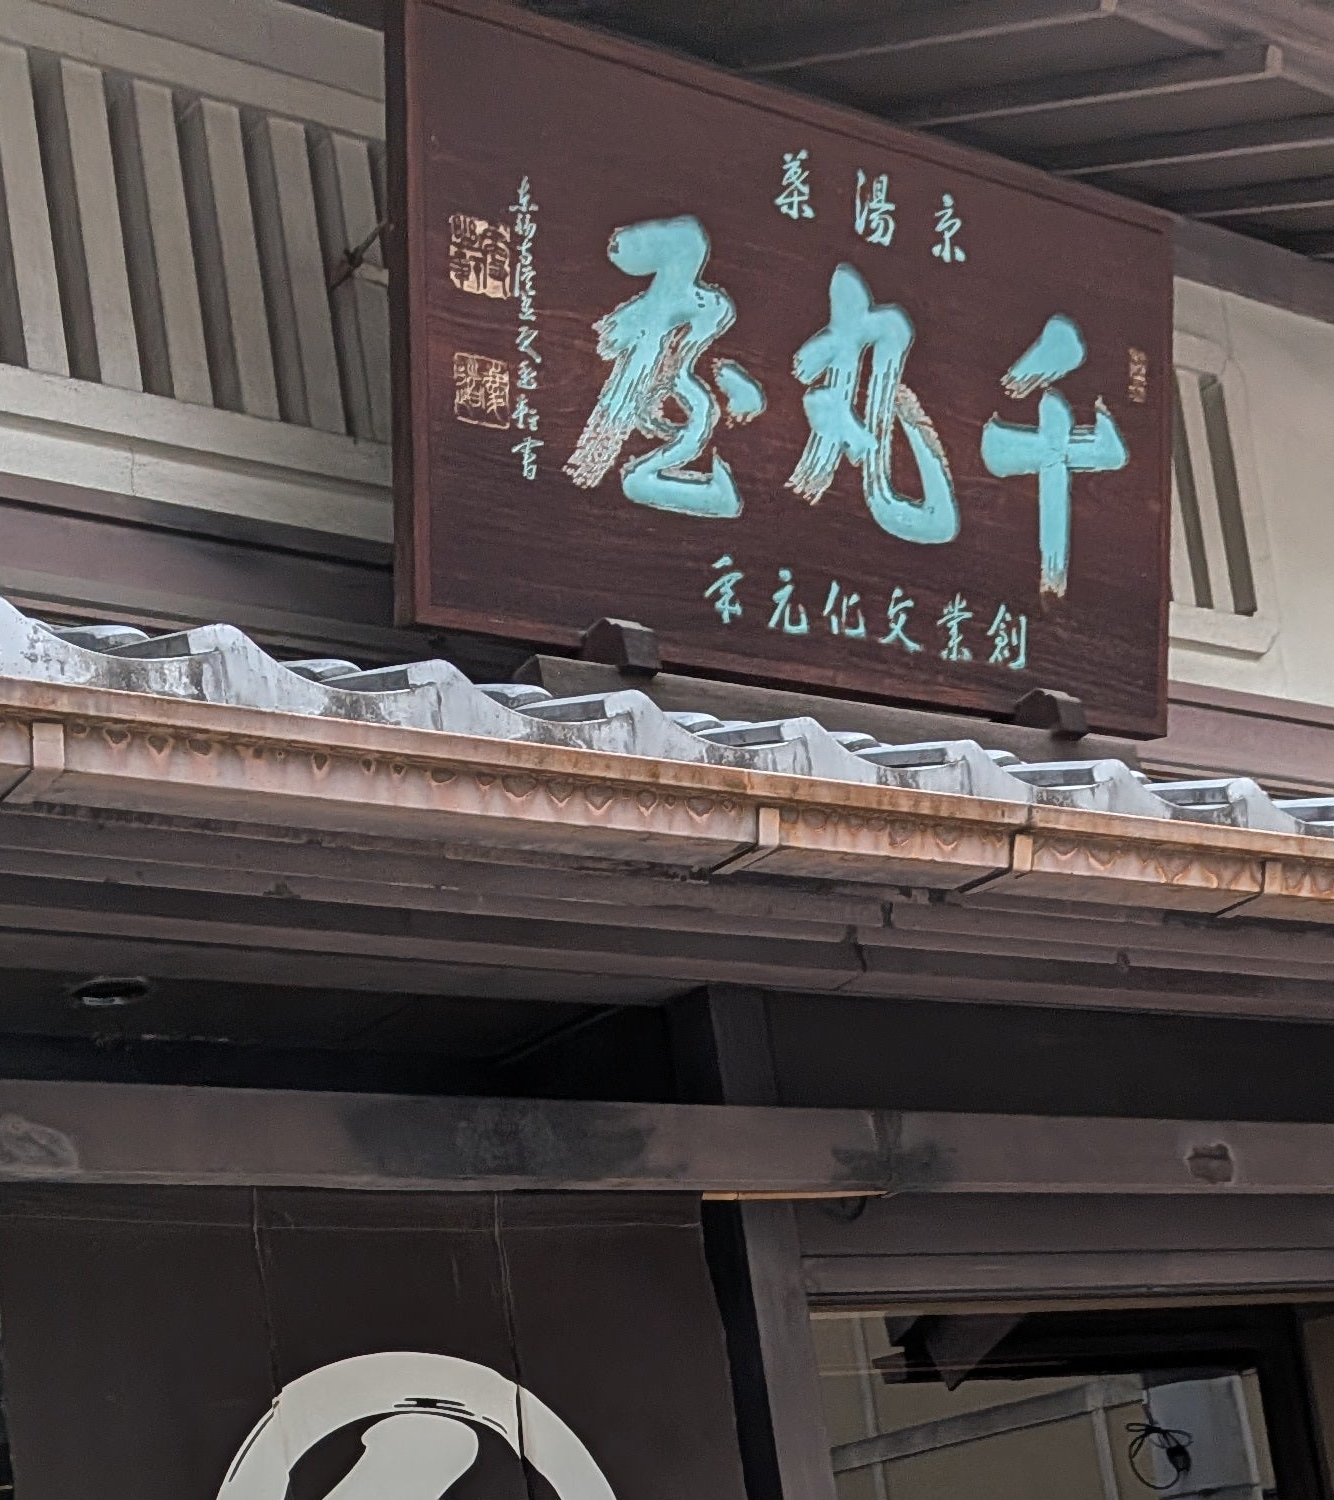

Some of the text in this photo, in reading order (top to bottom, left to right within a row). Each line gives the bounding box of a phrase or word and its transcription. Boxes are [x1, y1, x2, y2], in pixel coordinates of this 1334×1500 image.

[773, 150, 966, 263] 京湯葉
[563, 216, 1129, 598] 千丸屋
